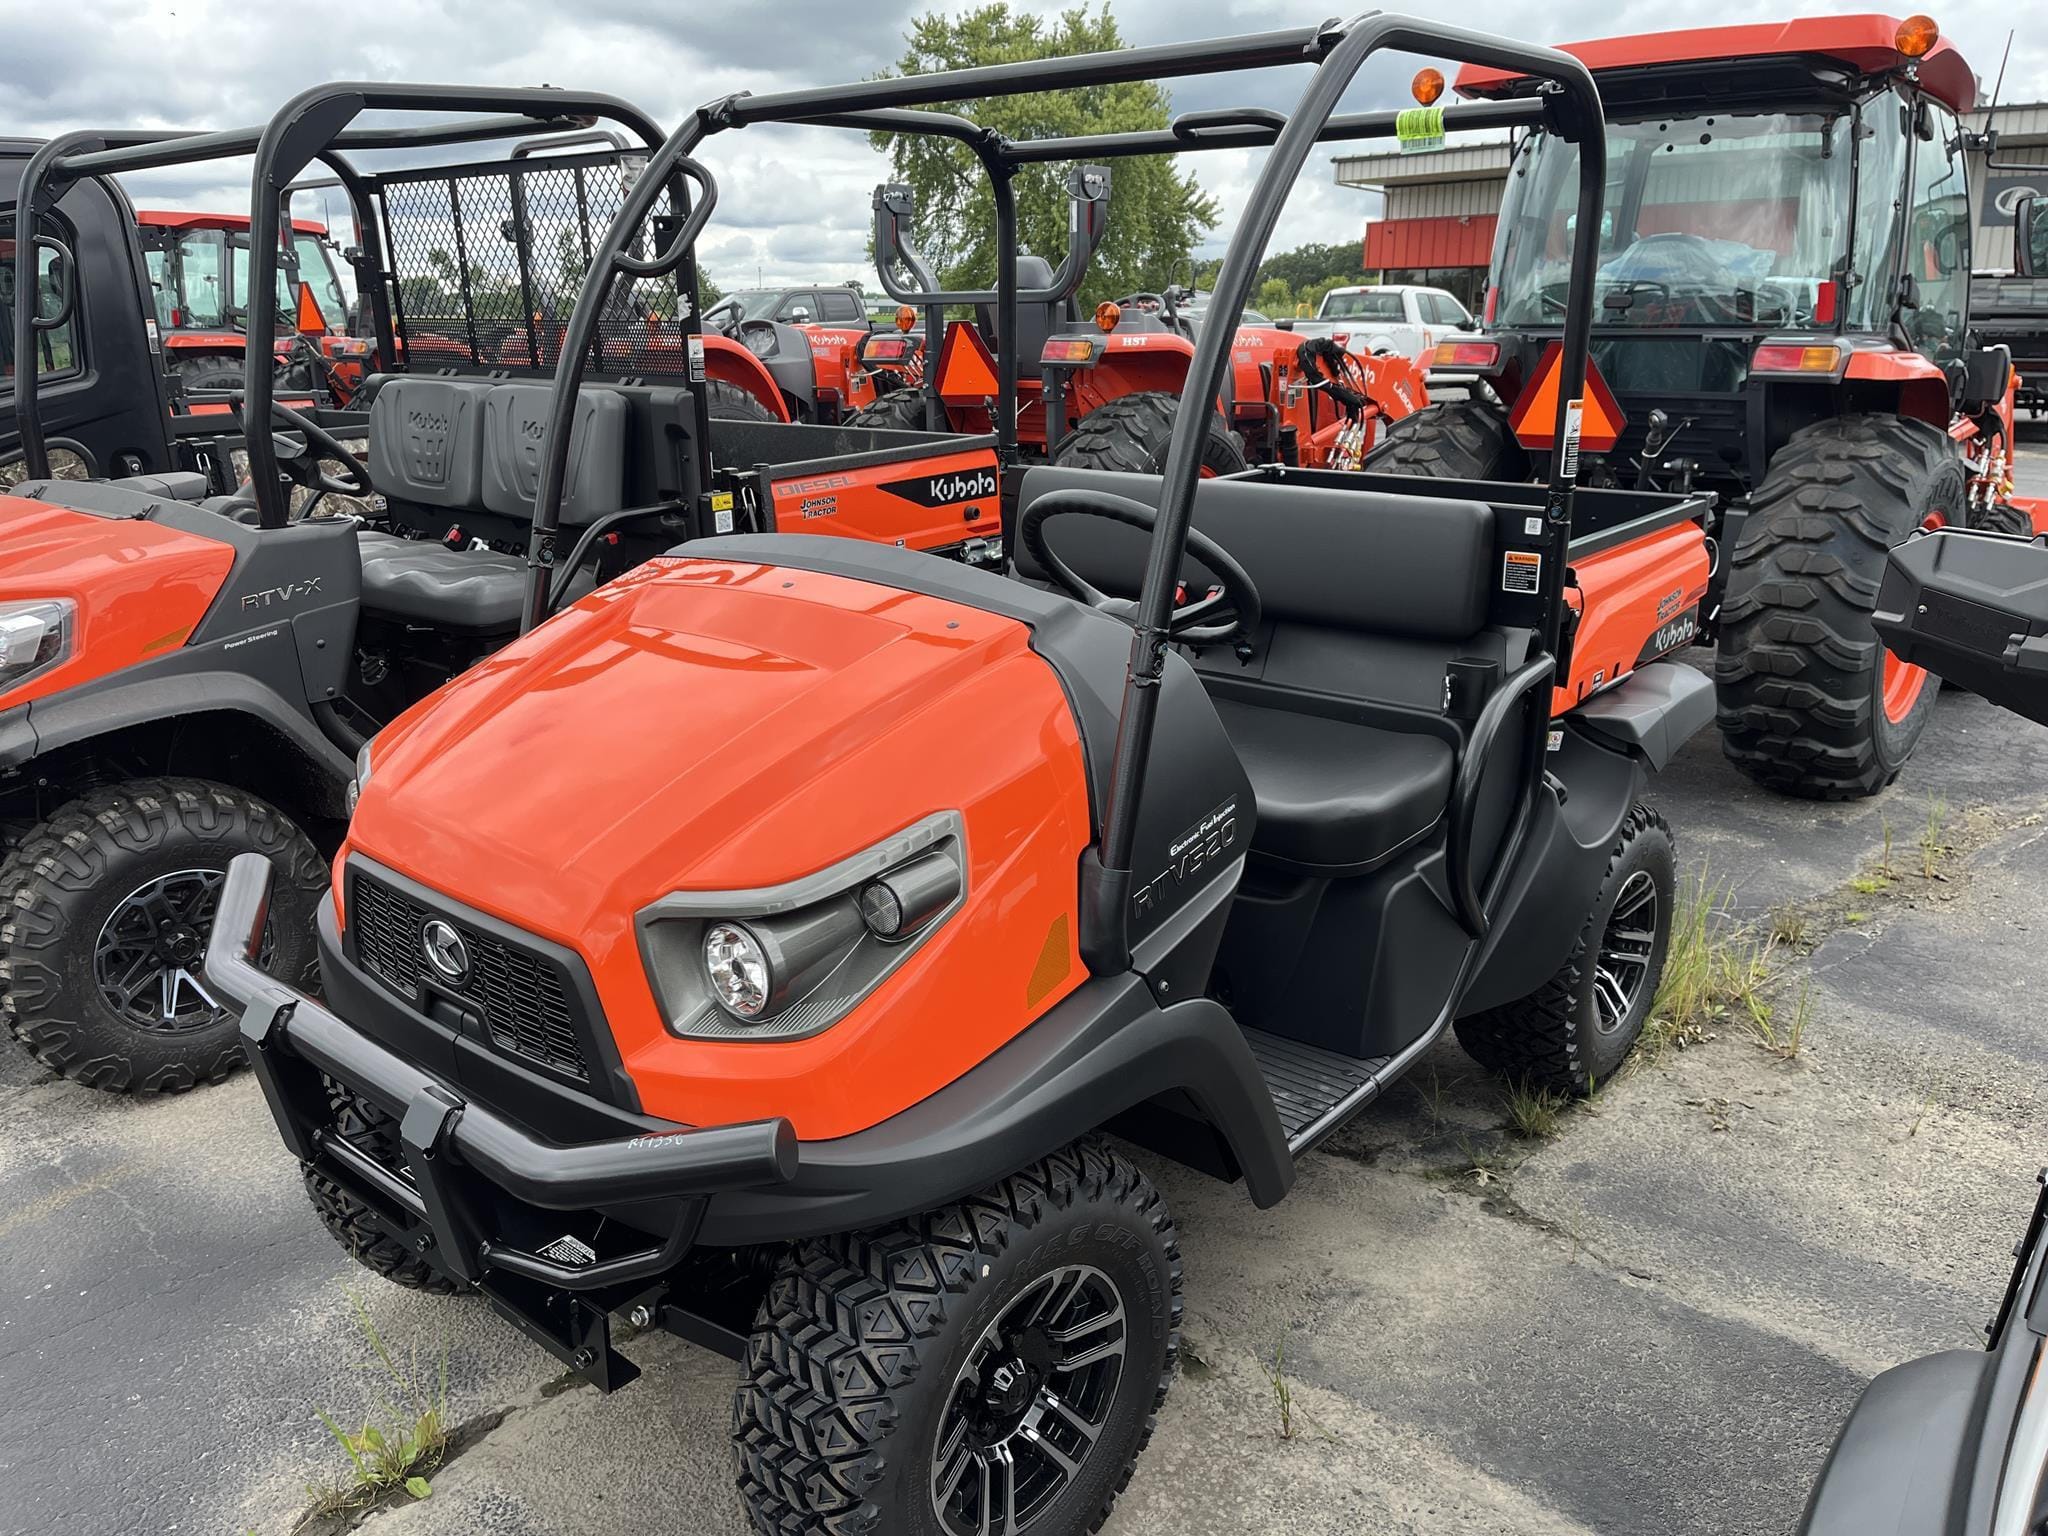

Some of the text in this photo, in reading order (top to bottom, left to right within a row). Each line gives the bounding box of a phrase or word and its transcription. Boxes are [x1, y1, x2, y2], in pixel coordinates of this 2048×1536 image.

[810, 335, 848, 346] Kubota
[1122, 336, 1148, 346] HST
[1232, 334, 1264, 347] ubota
[776, 475, 857, 497] DIESEL
[930, 471, 996, 501] Kubota
[241, 576, 322, 612] RTV-X
[224, 629, 278, 650] Power Steering
[1655, 617, 1693, 651] Kubota
[1132, 817, 1236, 920] RTV520
